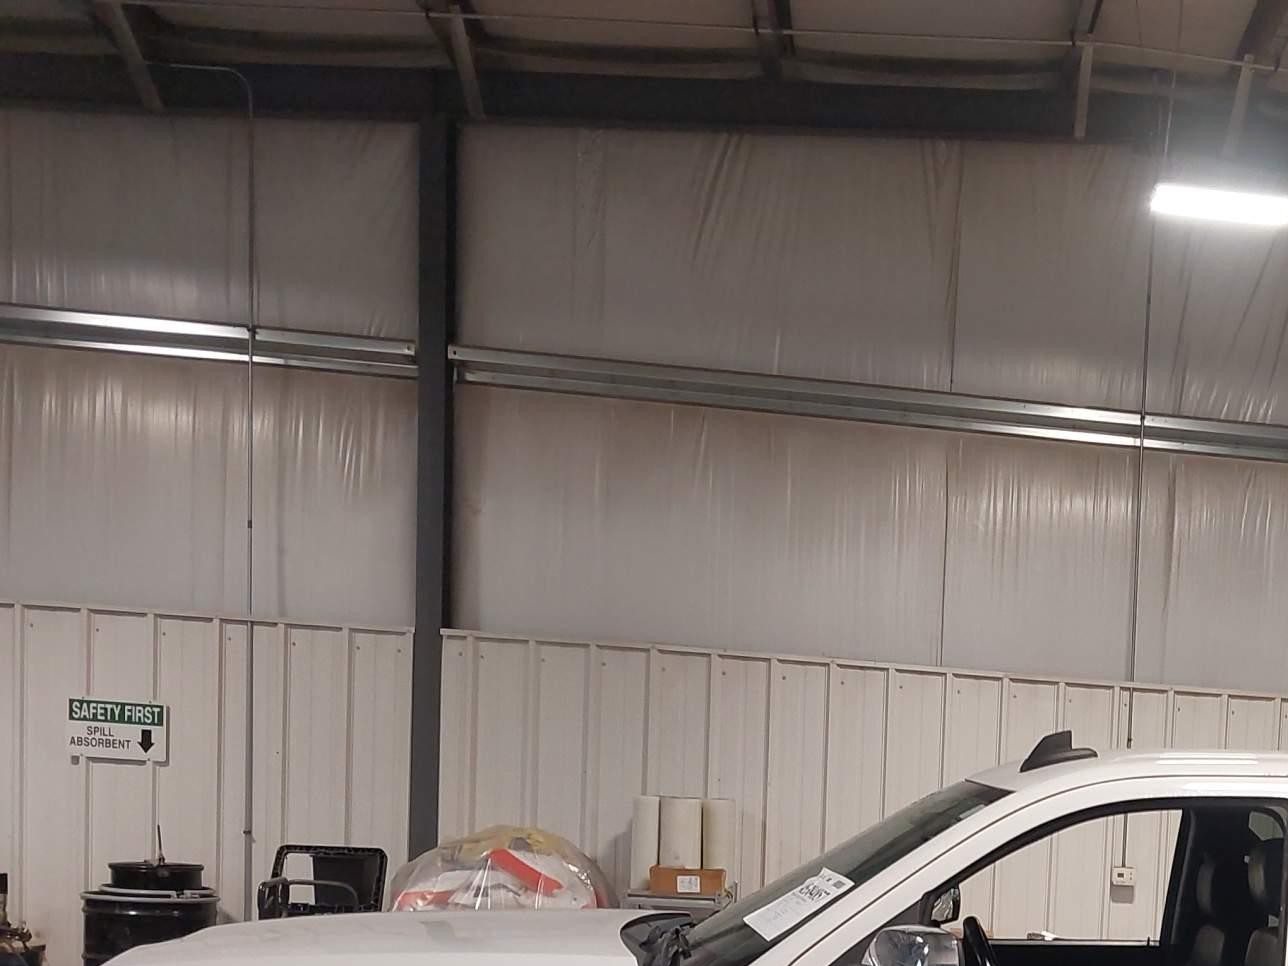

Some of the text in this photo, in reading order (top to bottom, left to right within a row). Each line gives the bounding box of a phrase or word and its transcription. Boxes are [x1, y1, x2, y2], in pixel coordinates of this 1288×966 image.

[72, 701, 161, 724] SAFETY FIRST
[86, 726, 114, 737] SPILL
[69, 736, 131, 749] ABSORBENT
